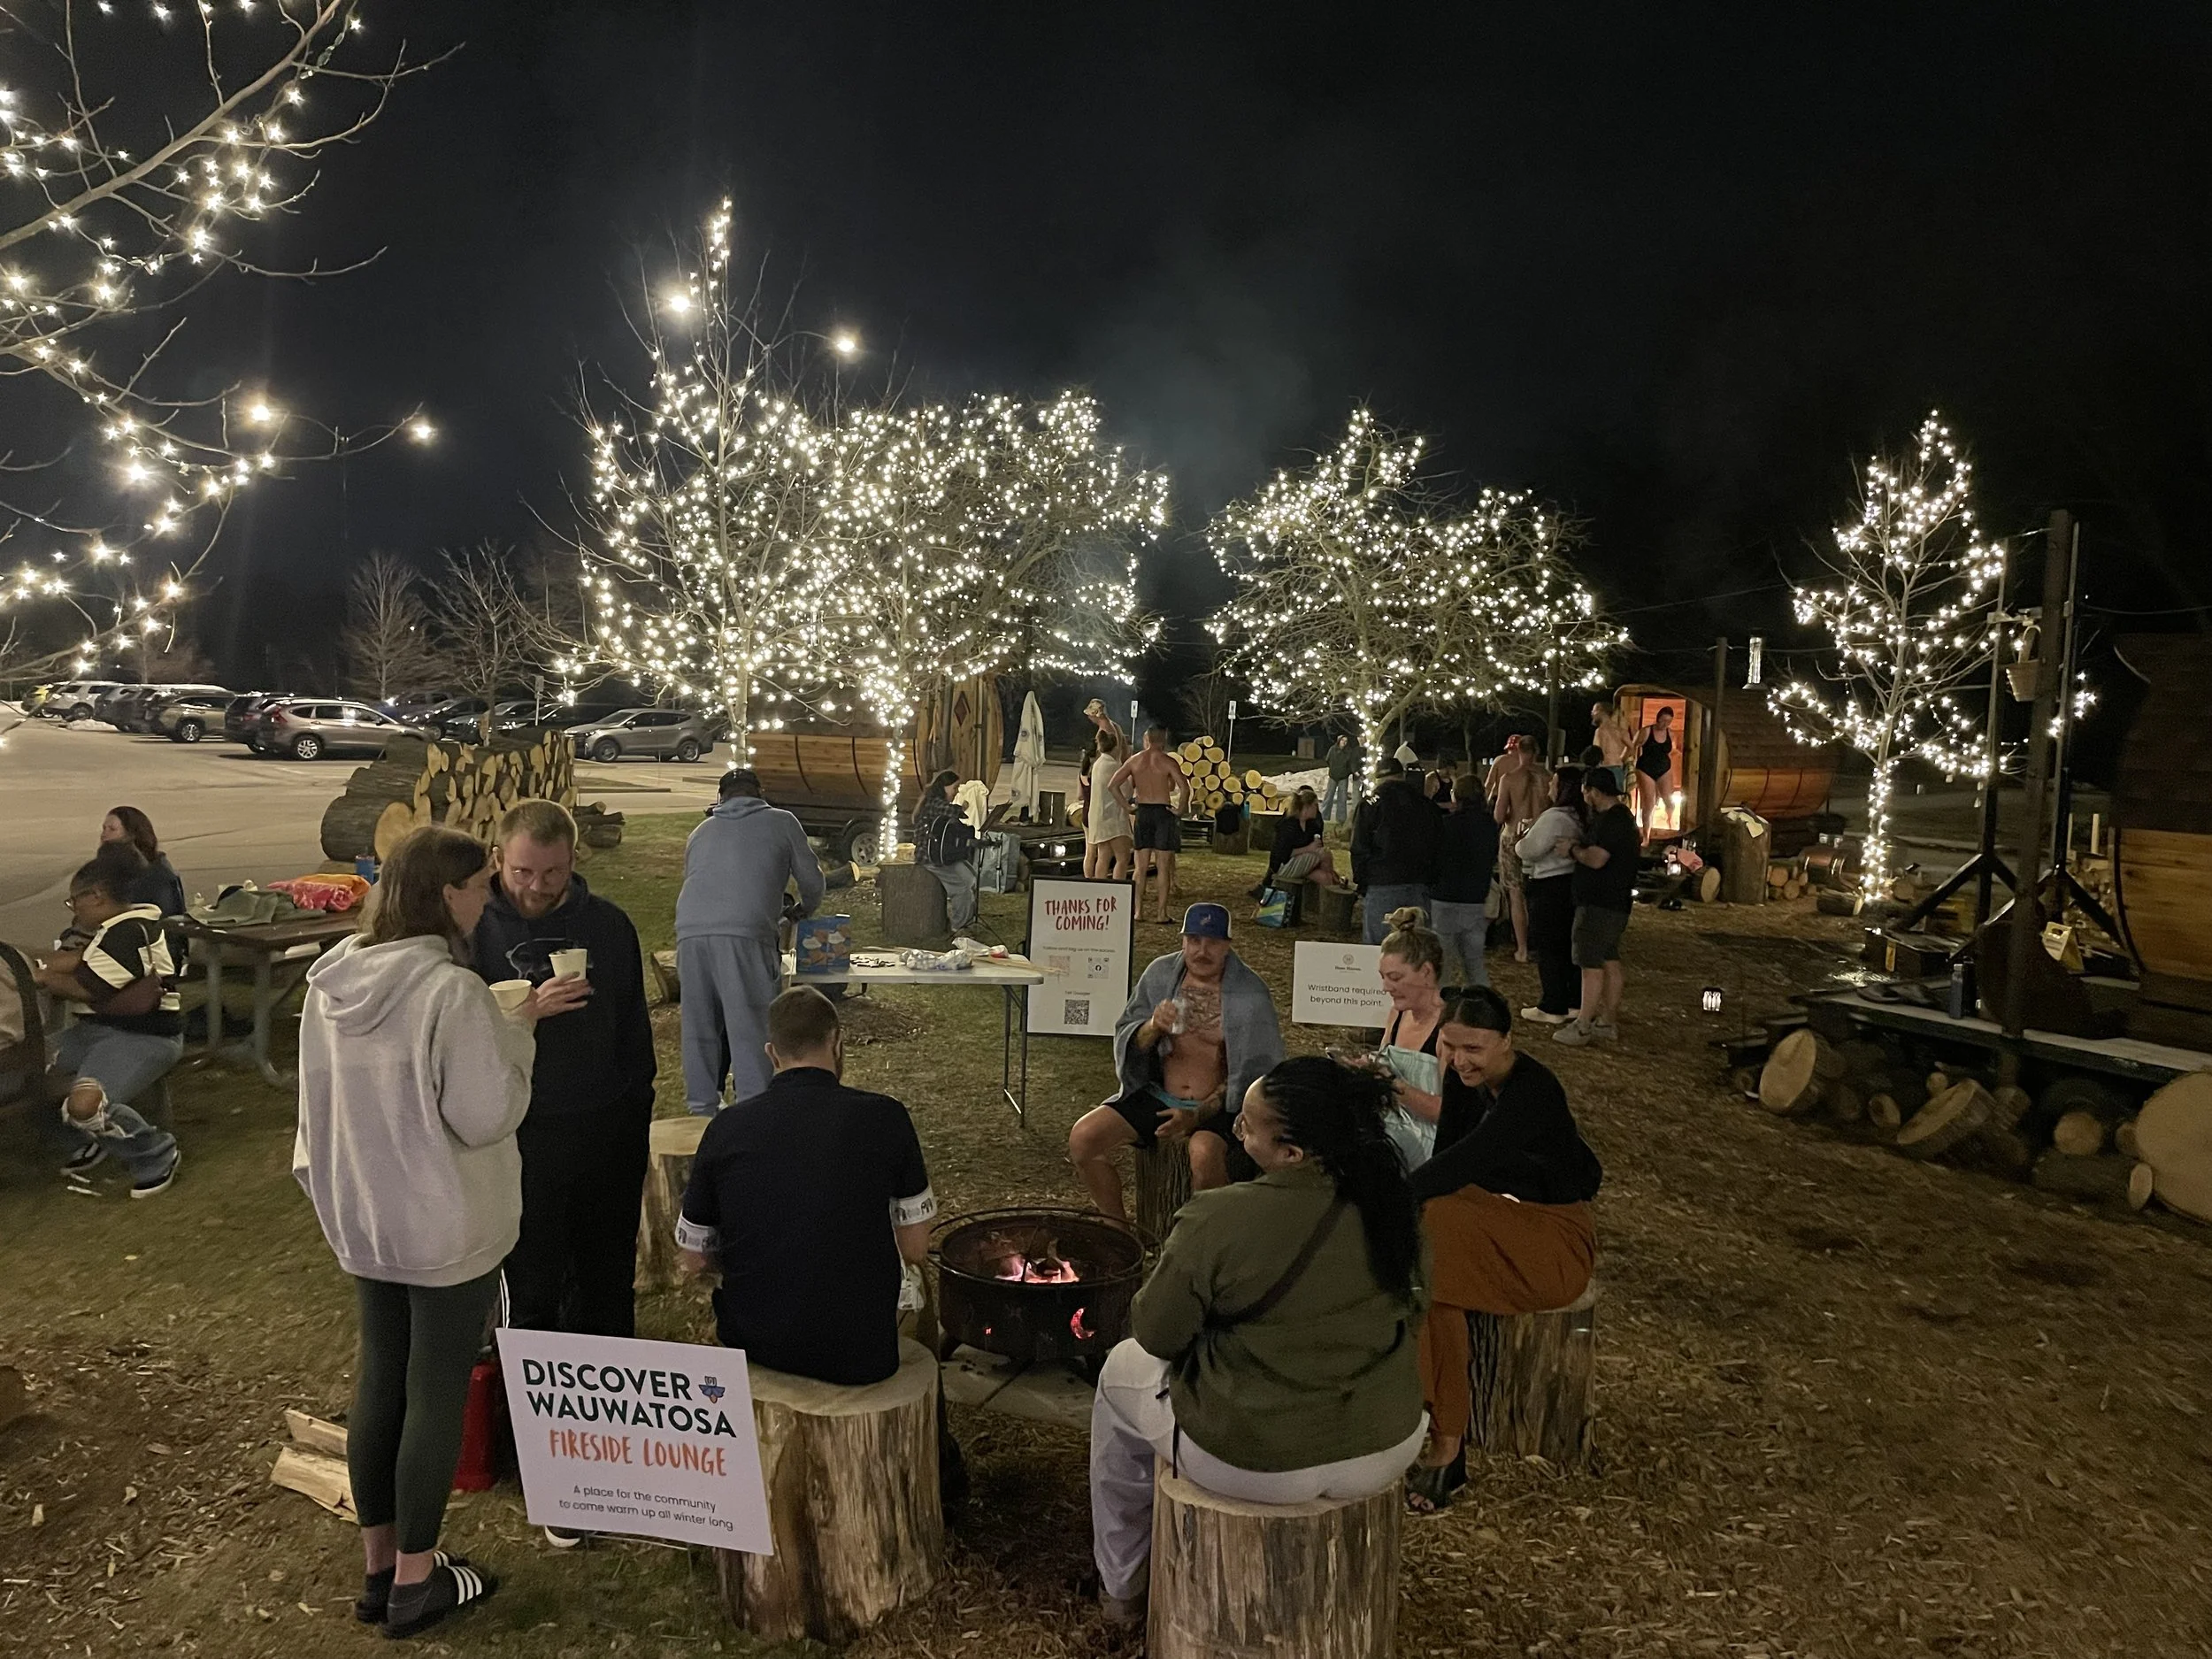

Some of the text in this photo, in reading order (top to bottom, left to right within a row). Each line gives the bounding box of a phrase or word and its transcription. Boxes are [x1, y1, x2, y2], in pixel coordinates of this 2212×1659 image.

[1045, 896, 1117, 915] THANKS FOR
[1056, 915, 1110, 931] COMING!
[1308, 984, 1386, 996] Wristband required
[1310, 995, 1341, 1004] beyond
[522, 1358, 693, 1401] DISCOVER
[526, 1391, 737, 1438] WAUWATOSA
[549, 1428, 727, 1477] FIRESIDE LOUNGE
[573, 1485, 717, 1514] A place for the community
[559, 1499, 733, 1532] to come warm up all winter long
